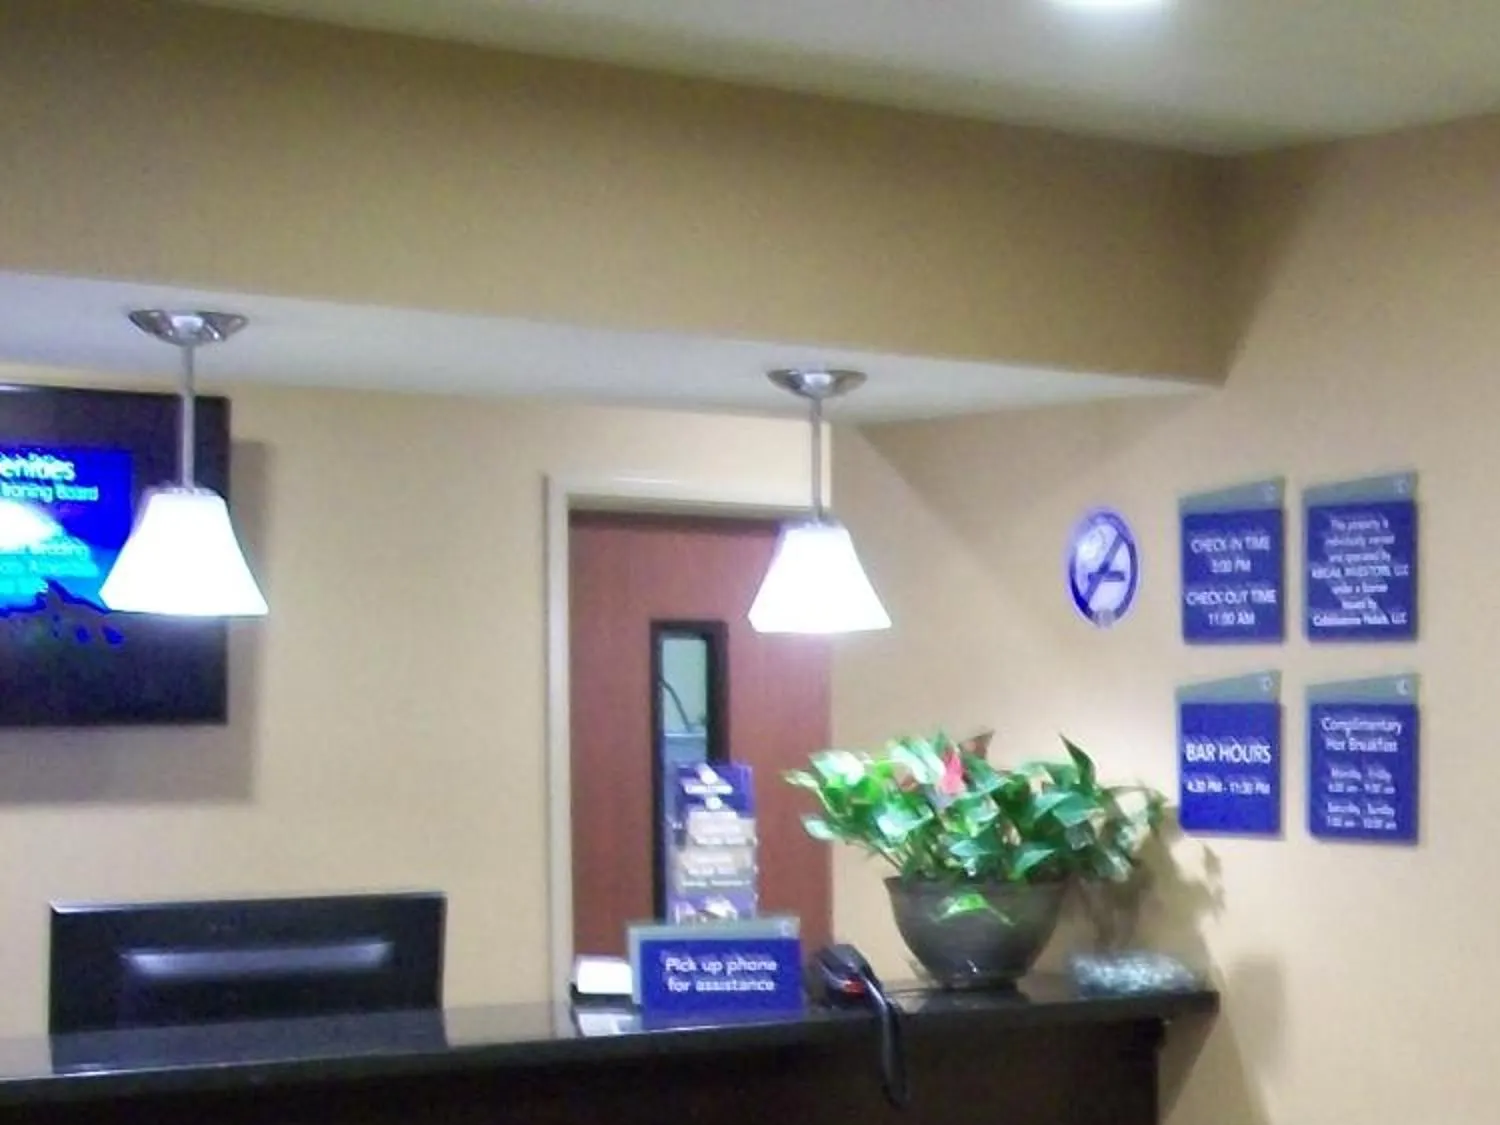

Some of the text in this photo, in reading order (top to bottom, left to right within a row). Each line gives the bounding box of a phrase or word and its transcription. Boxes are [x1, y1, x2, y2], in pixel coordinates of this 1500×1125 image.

[1320, 717, 1403, 737] Complimentary
[1185, 743, 1272, 764] BAR HOURS
[665, 957, 778, 976] Pick up phone
[667, 977, 775, 992] for assistance
